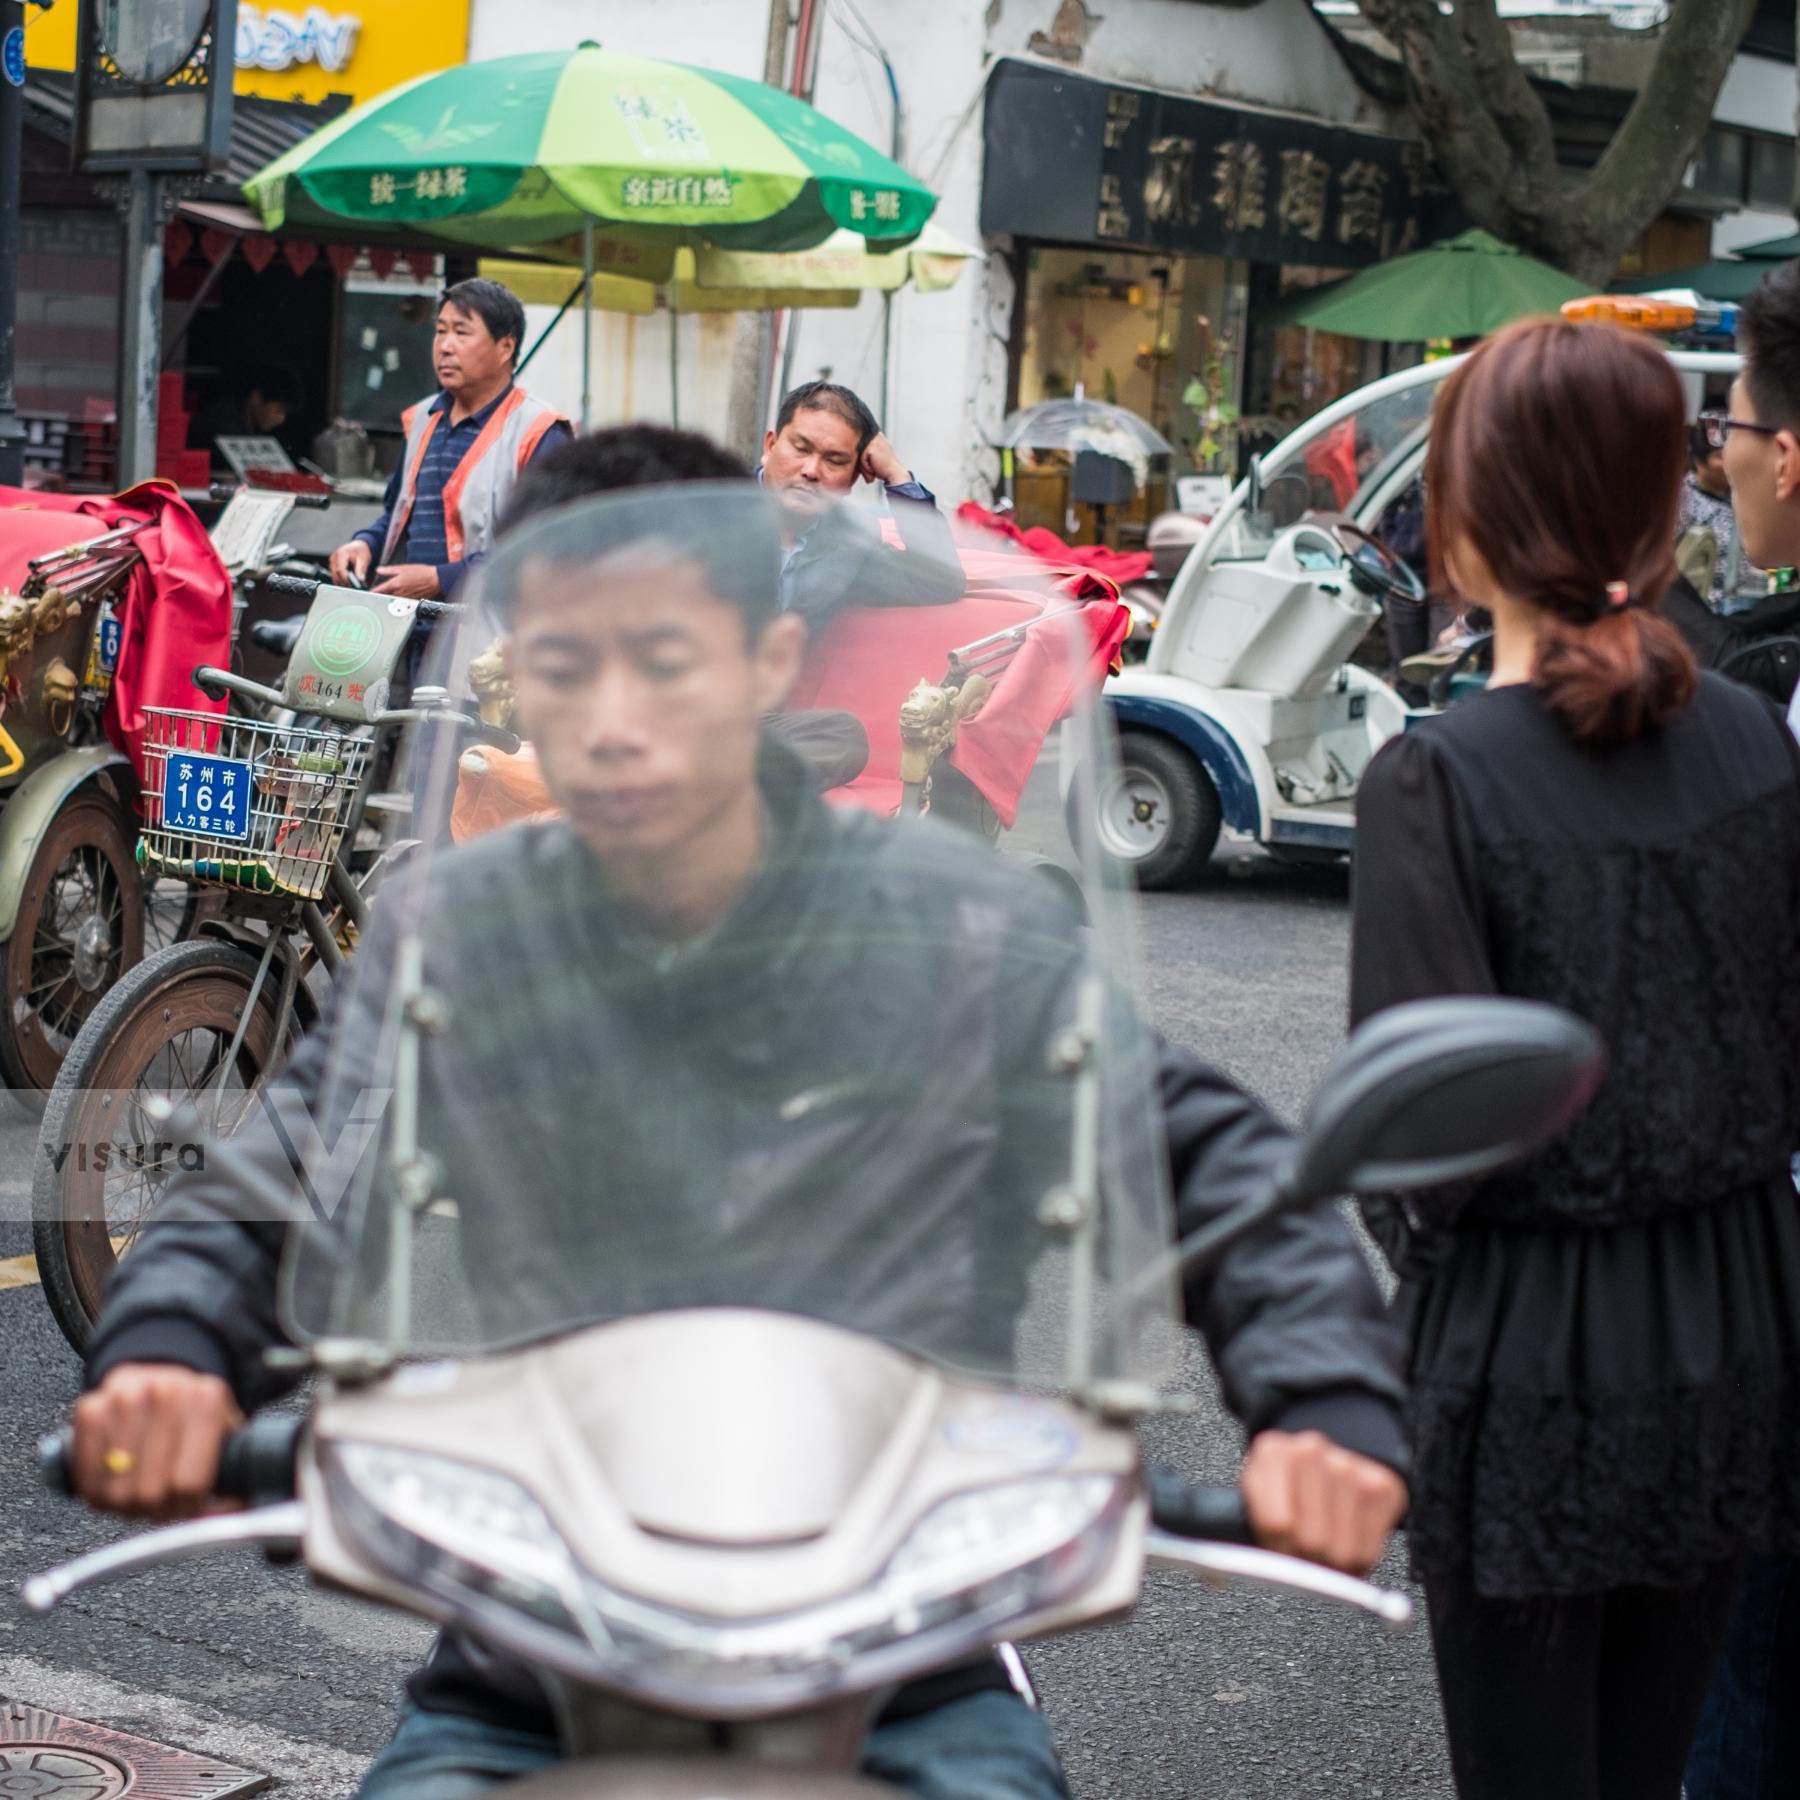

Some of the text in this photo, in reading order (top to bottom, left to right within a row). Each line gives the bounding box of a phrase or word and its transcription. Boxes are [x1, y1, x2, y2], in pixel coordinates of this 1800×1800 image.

[624, 176, 732, 206] 亲近自然
[179, 763, 236, 787] 苏州市
[178, 783, 236, 816] 164
[174, 812, 236, 833] 人力客三轮
